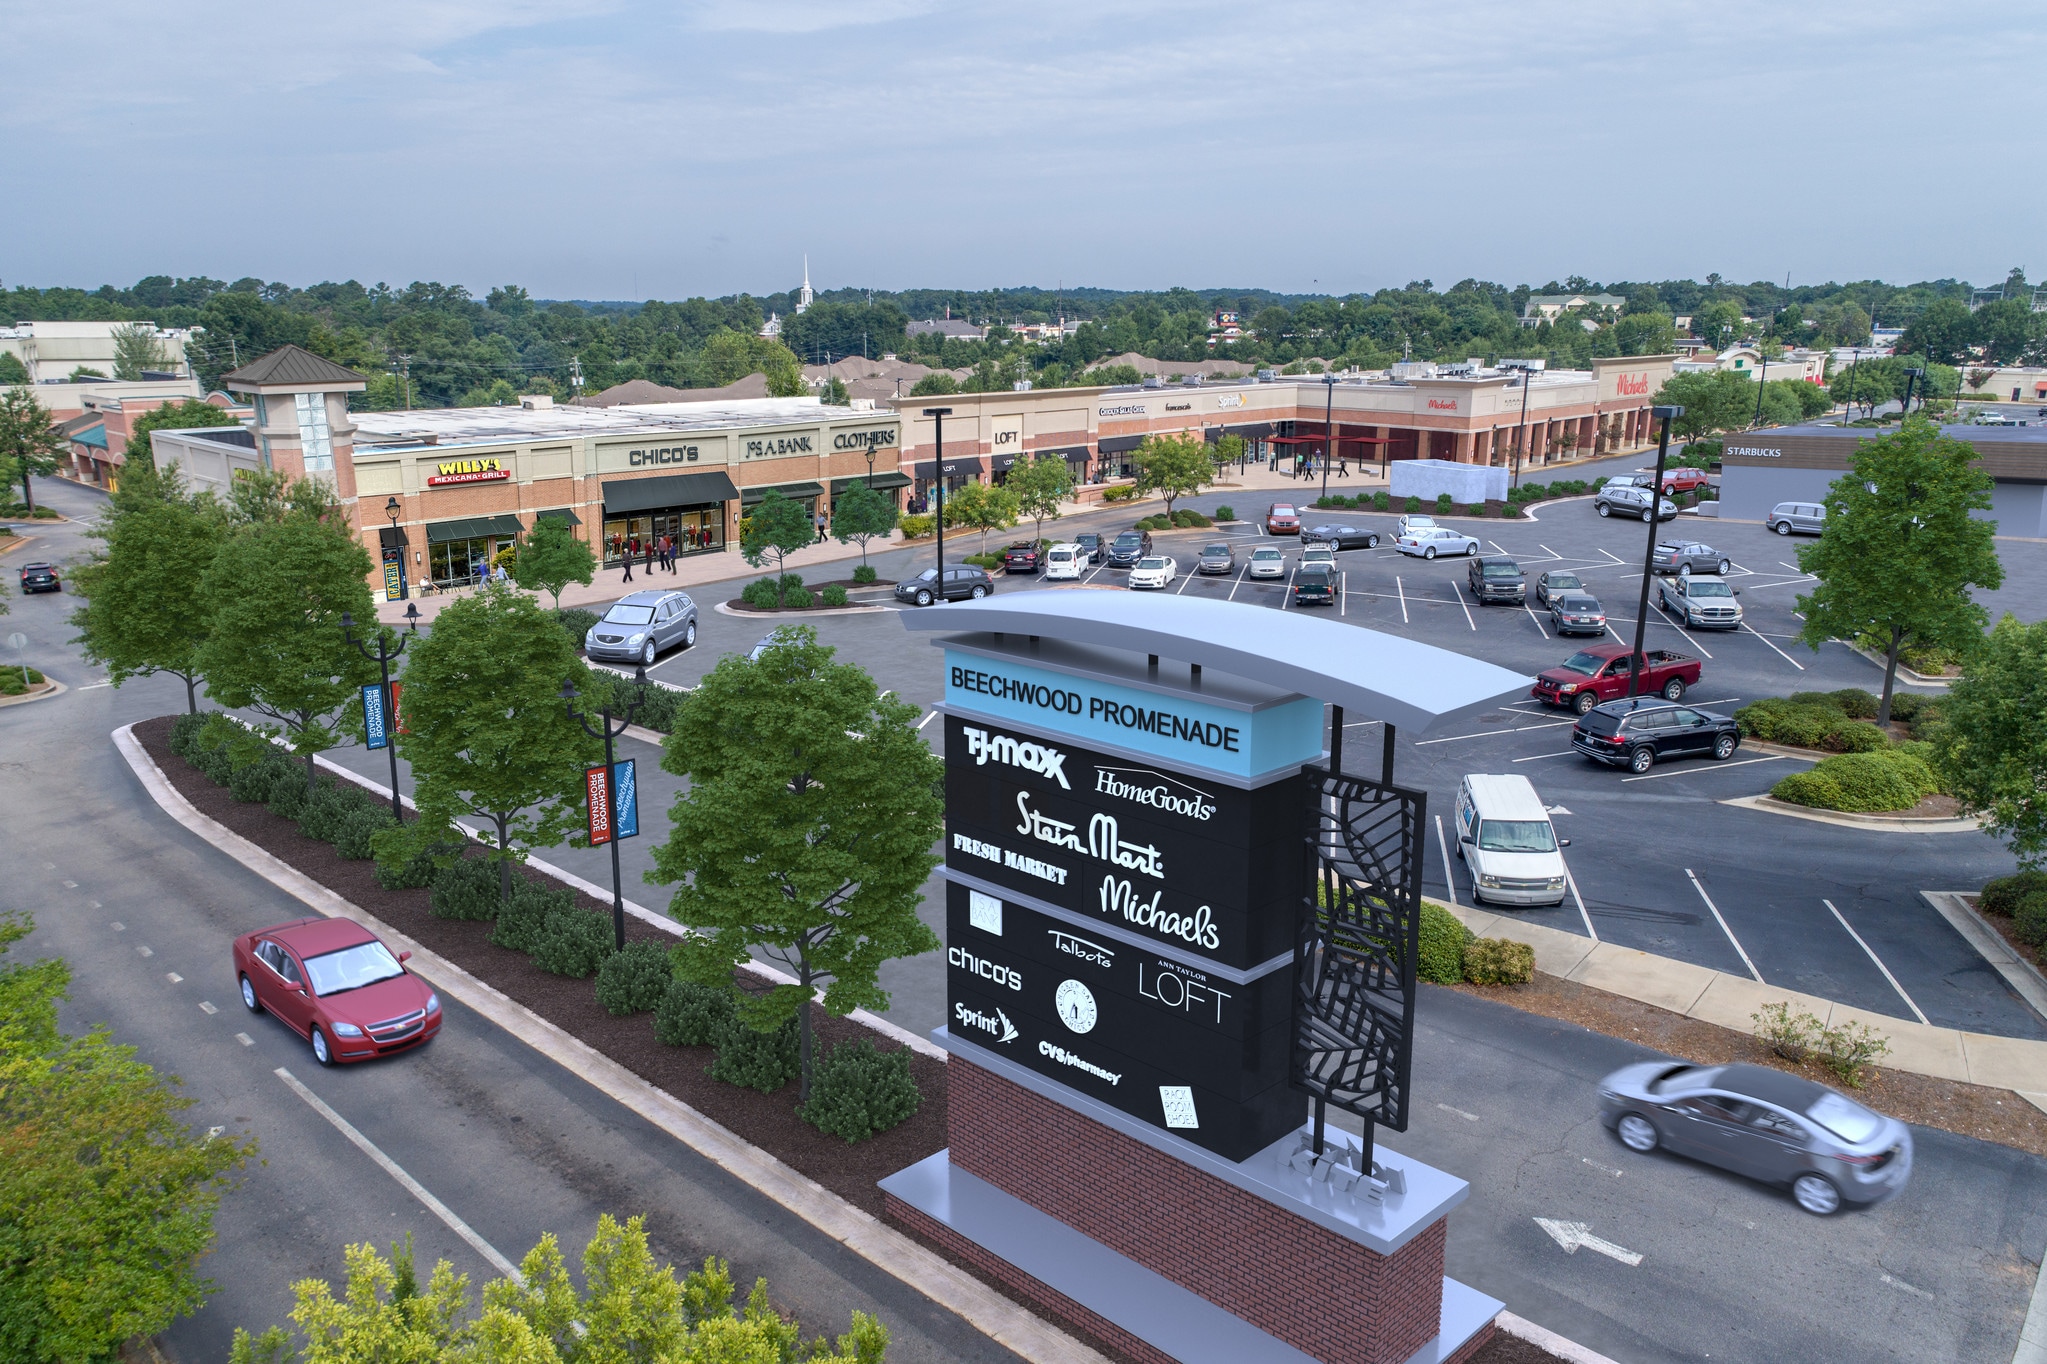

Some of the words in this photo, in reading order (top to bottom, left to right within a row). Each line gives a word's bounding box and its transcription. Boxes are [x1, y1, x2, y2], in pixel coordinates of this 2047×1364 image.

[1617, 372, 1648, 396] Michaels
[1218, 395, 1239, 410] Sprint
[1428, 399, 1457, 410] Michaels
[778, 436, 813, 454] BANK
[834, 429, 895, 449] CLOTHIERS
[994, 431, 1018, 445] LOFT
[629, 445, 699, 465] CHICO'S
[1727, 446, 1782, 458] STARBUCKS
[438, 458, 501, 476] WILLY'S
[366, 690, 377, 739] PROMENADE
[372, 689, 383, 738] BEECHWOOD
[951, 667, 1083, 715] BEECHWOOD
[1090, 697, 1240, 753] PROMENADE
[590, 774, 601, 833] PROMENADE
[597, 772, 608, 832] BEECHWOOD
[1016, 790, 1089, 855] Stein
[1088, 812, 1165, 879] Mart
[953, 833, 1002, 864] FRESH
[1003, 849, 1068, 886] MARKET
[1099, 874, 1221, 950] Michaels
[1048, 929, 1115, 968] Talbots
[1157, 960, 1174, 970] ANN
[1175, 965, 1207, 982] TAYLOR
[1139, 962, 1232, 1024] LOFT
[955, 1002, 999, 1036] Sprint
[1039, 1041, 1122, 1086] CVS/pharmacy
[1164, 1089, 1188, 1100] RACK
[1164, 1101, 1193, 1113] ROOM
[1167, 1113, 1195, 1125] SHOES
